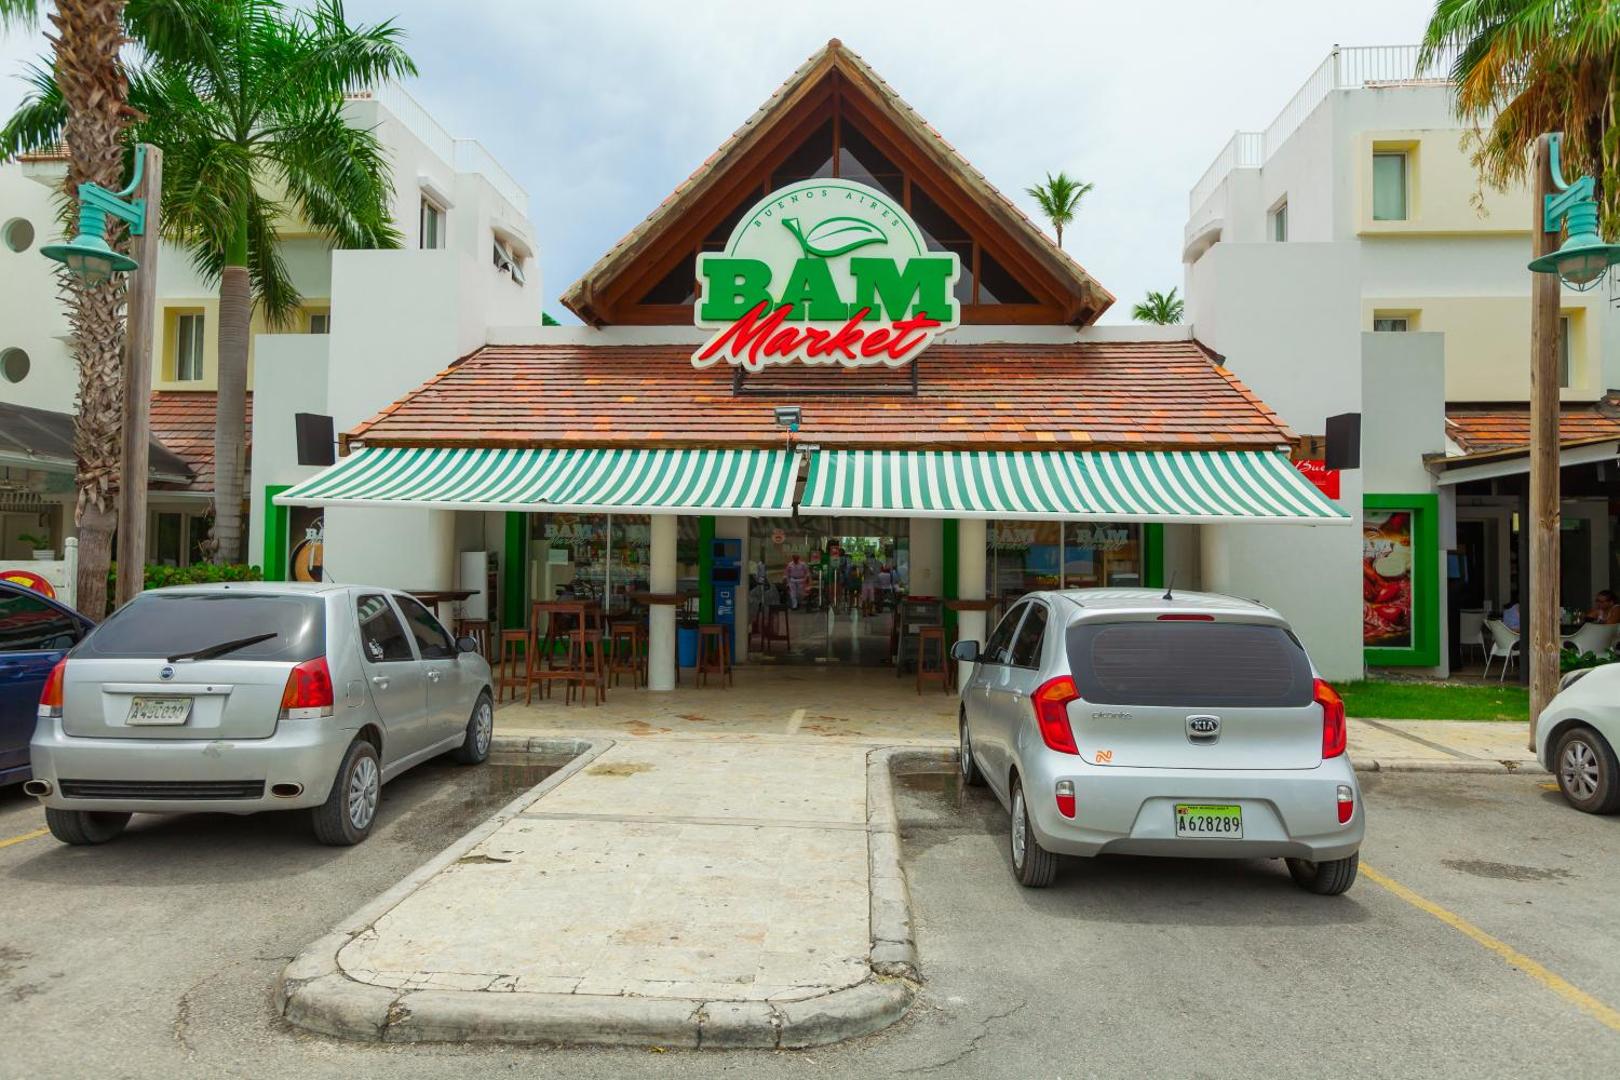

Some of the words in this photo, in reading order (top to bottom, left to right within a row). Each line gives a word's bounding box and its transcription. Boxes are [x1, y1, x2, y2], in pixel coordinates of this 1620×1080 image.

[753, 189, 828, 228] BUENOS
[845, 191, 900, 228] AIRES
[700, 257, 954, 323] BAM
[698, 299, 942, 366] Market
[1194, 720, 1215, 731] KIA
[1178, 815, 1240, 832] A628289
